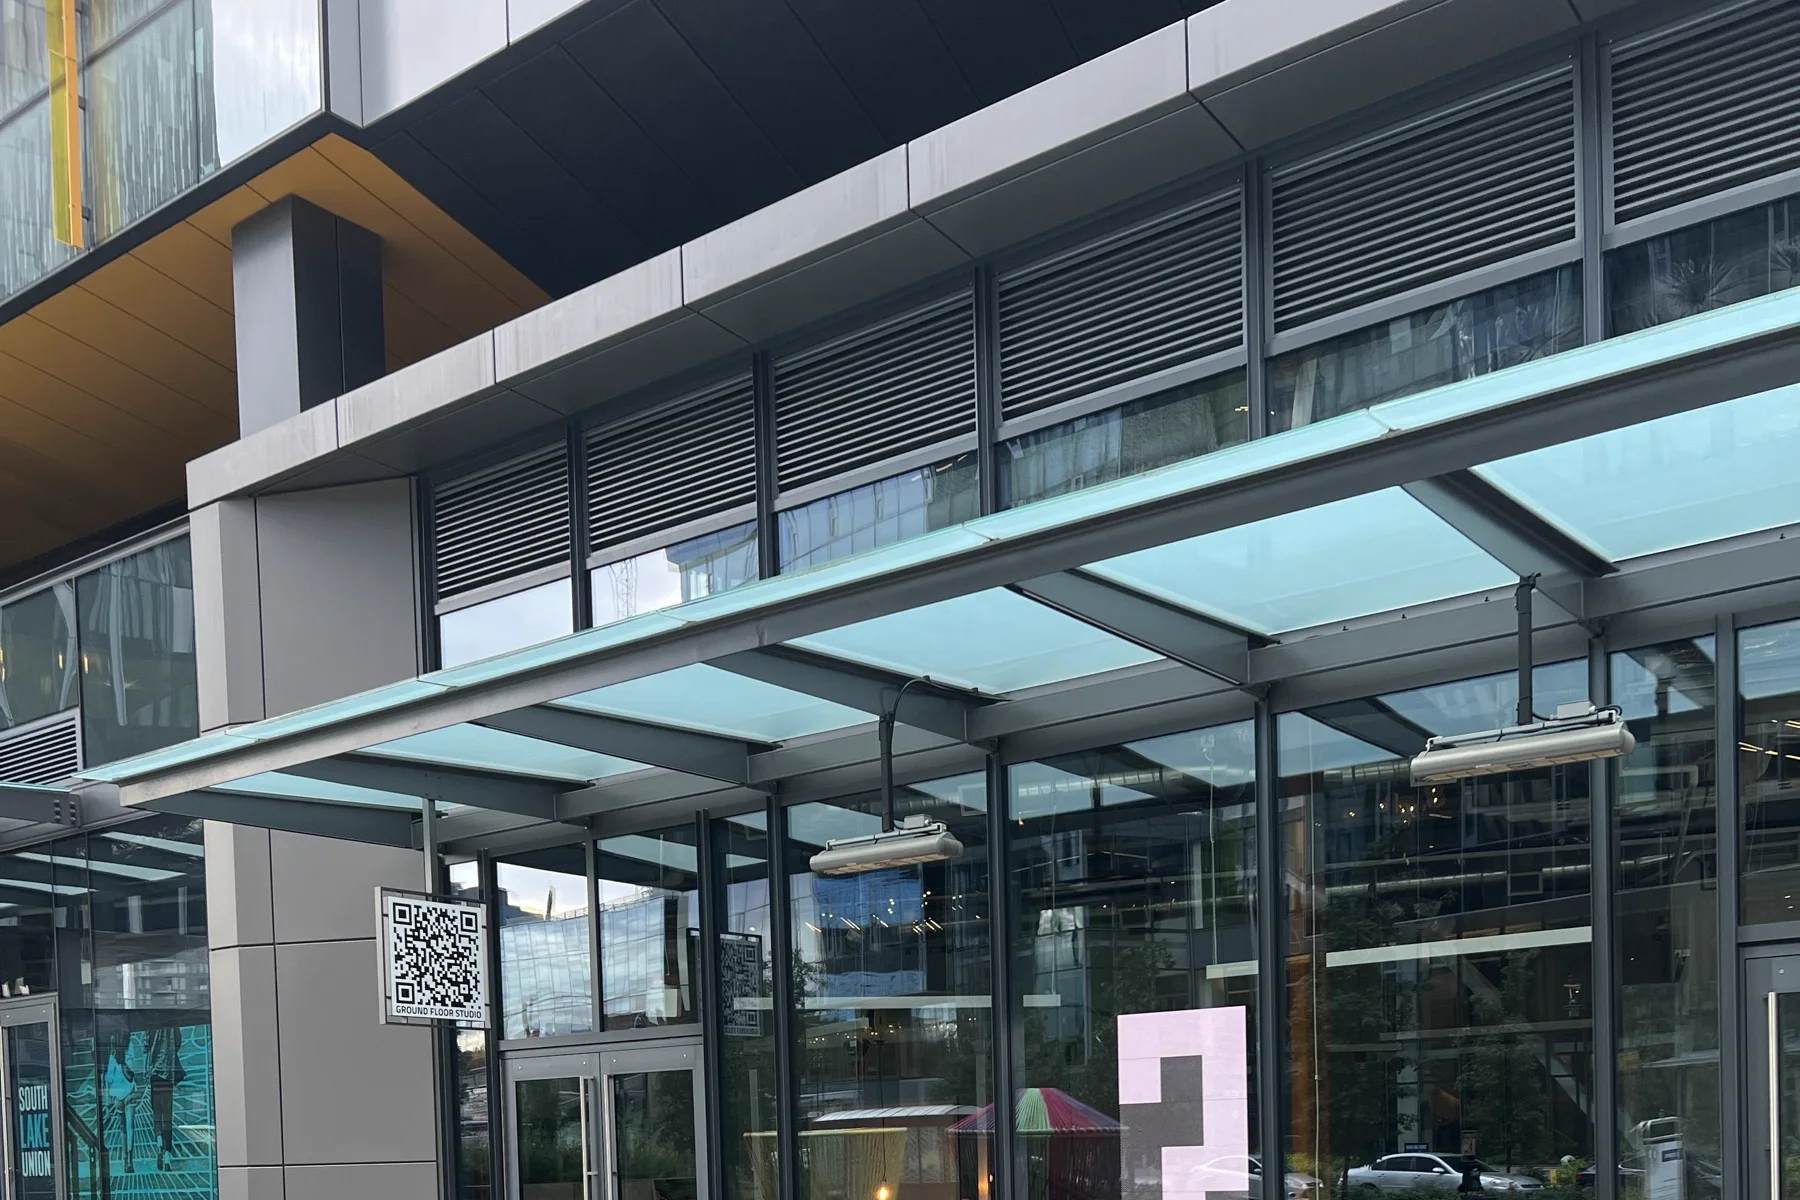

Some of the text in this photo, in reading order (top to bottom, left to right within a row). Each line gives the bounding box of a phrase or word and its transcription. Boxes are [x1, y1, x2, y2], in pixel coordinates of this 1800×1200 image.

[396, 1005, 482, 1019] GROUND FLOOR STUDIO
[18, 1084, 48, 1111] SOUTH
[20, 1113, 50, 1148] LAKE
[21, 1150, 51, 1177] UNION
